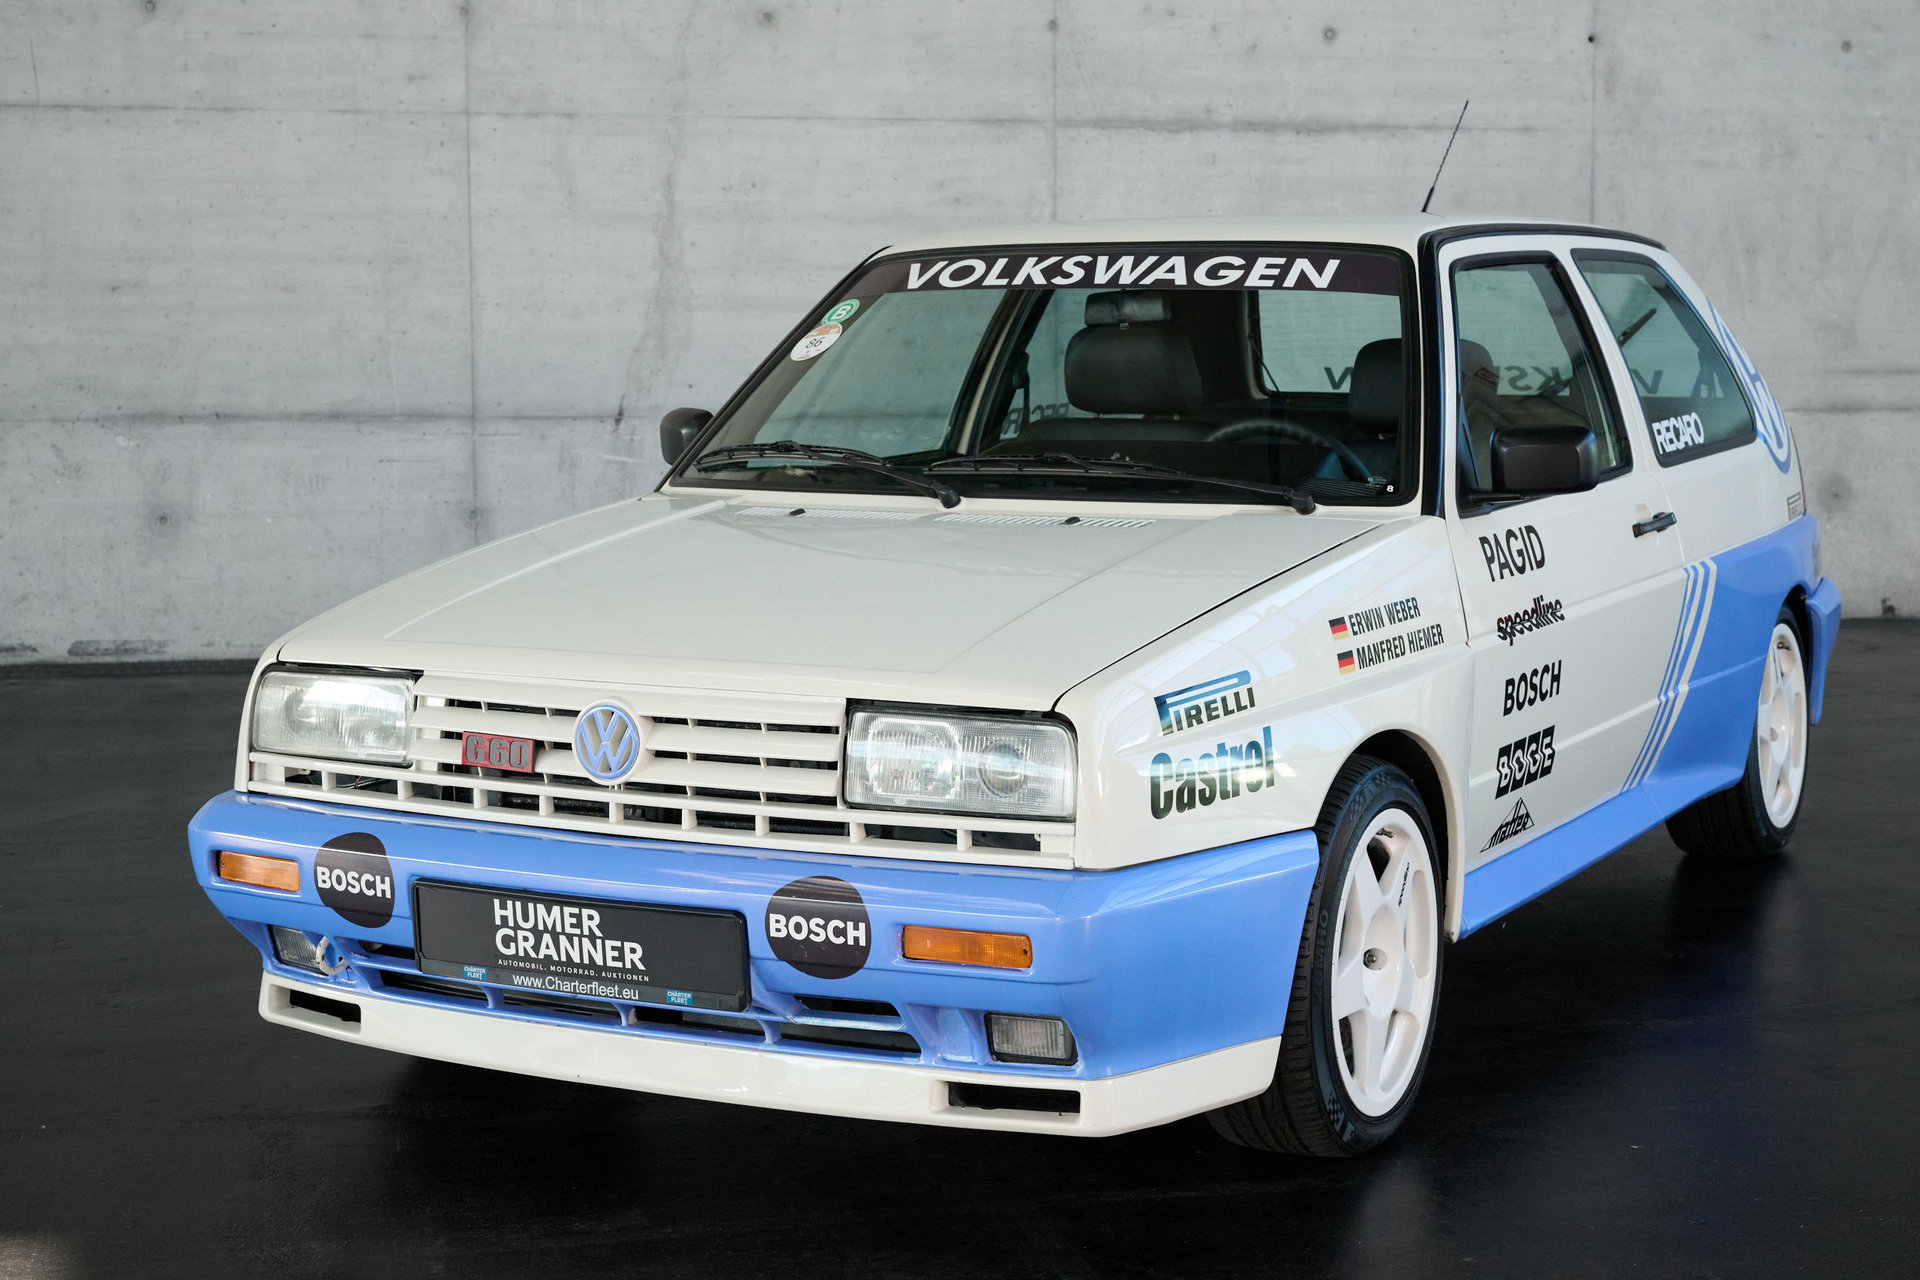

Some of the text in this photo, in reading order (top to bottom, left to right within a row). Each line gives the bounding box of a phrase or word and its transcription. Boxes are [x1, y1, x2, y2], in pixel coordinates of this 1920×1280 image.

[907, 255, 1341, 290] VOLKSWAGEN
[831, 304, 853, 320] B
[805, 336, 826, 349] 86
[1652, 411, 1705, 455] RECARO
[1386, 484, 1395, 493] 8
[1479, 524, 1546, 582] PAGID
[1348, 597, 1422, 636] ERWIN WEBER
[1496, 595, 1565, 646] speedline
[1356, 624, 1445, 670] MANFRED HIEMER
[1154, 670, 1256, 736] PIRELLI
[1503, 659, 1562, 717] BOSCH
[466, 735, 529, 769] G60
[1498, 734, 1554, 790] BOGE
[1150, 725, 1275, 820] Castrol
[316, 865, 392, 899] BOSCH
[493, 898, 603, 937] HUMER
[769, 913, 867, 947] BOSCH
[495, 927, 646, 970] GRANNER
[498, 959, 650, 982] AUTOMOBIL. MOTORRAD. AUKTIONEN
[512, 974, 639, 1000] www.Charterfleet.eu
